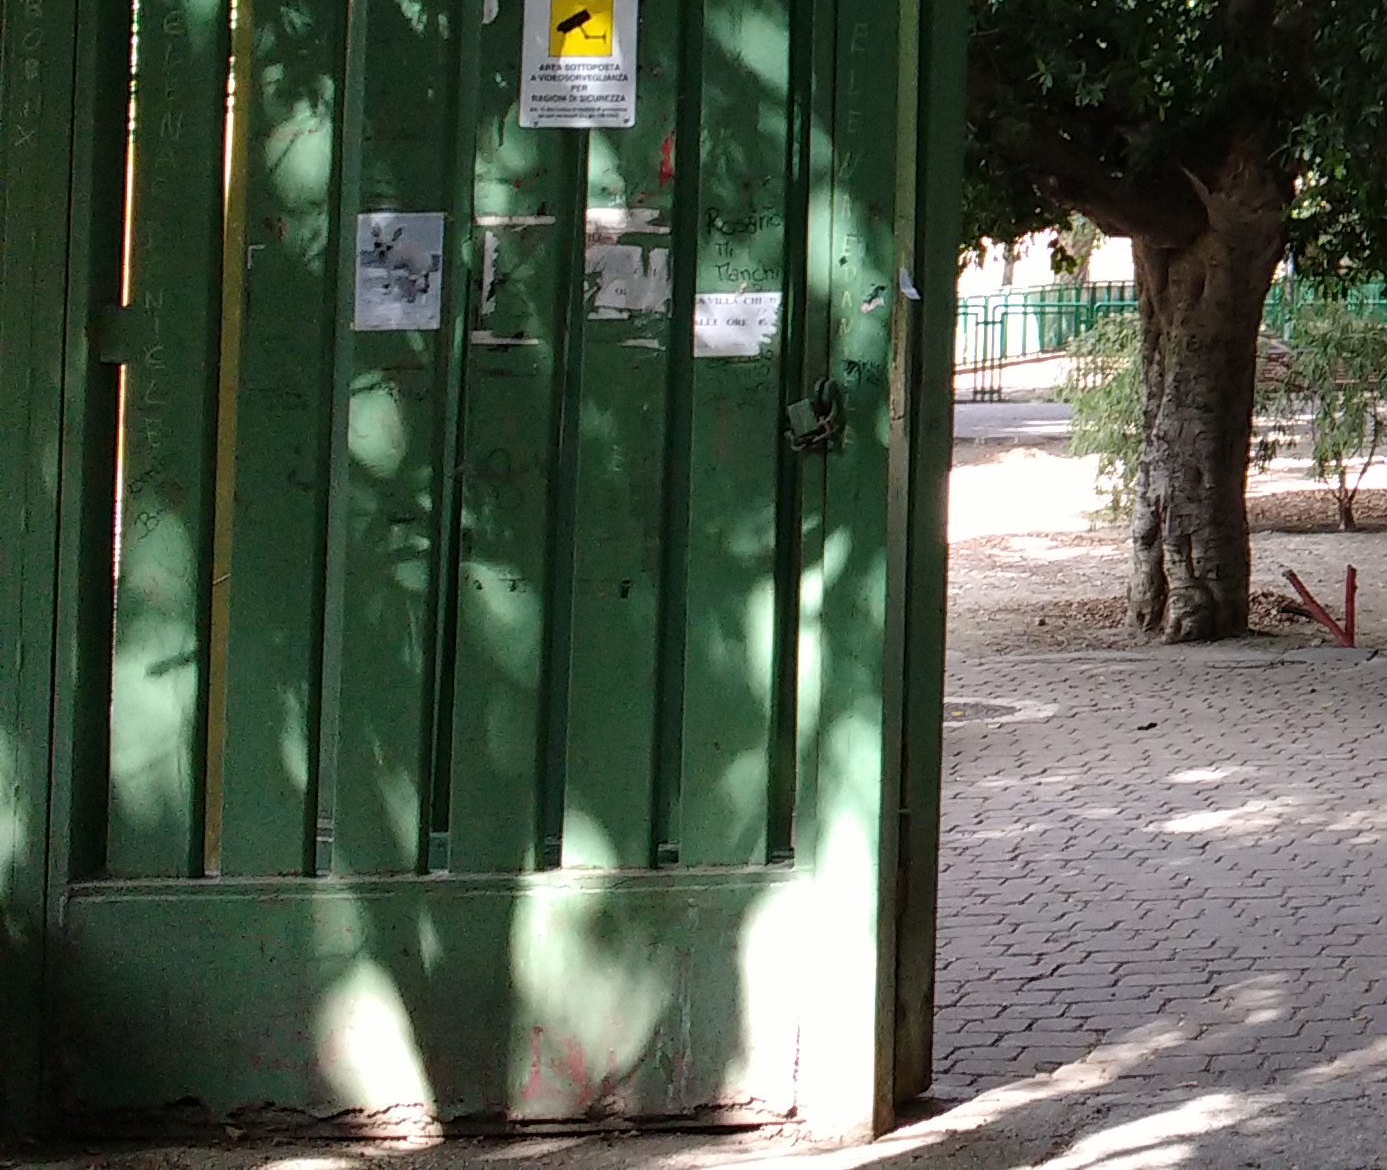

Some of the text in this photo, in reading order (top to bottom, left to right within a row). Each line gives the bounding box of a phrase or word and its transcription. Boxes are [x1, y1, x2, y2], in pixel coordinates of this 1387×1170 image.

[564, 63, 621, 71] SOTTOPOSTA
[570, 84, 588, 92] PER
[580, 94, 626, 102] SICUREZZA
